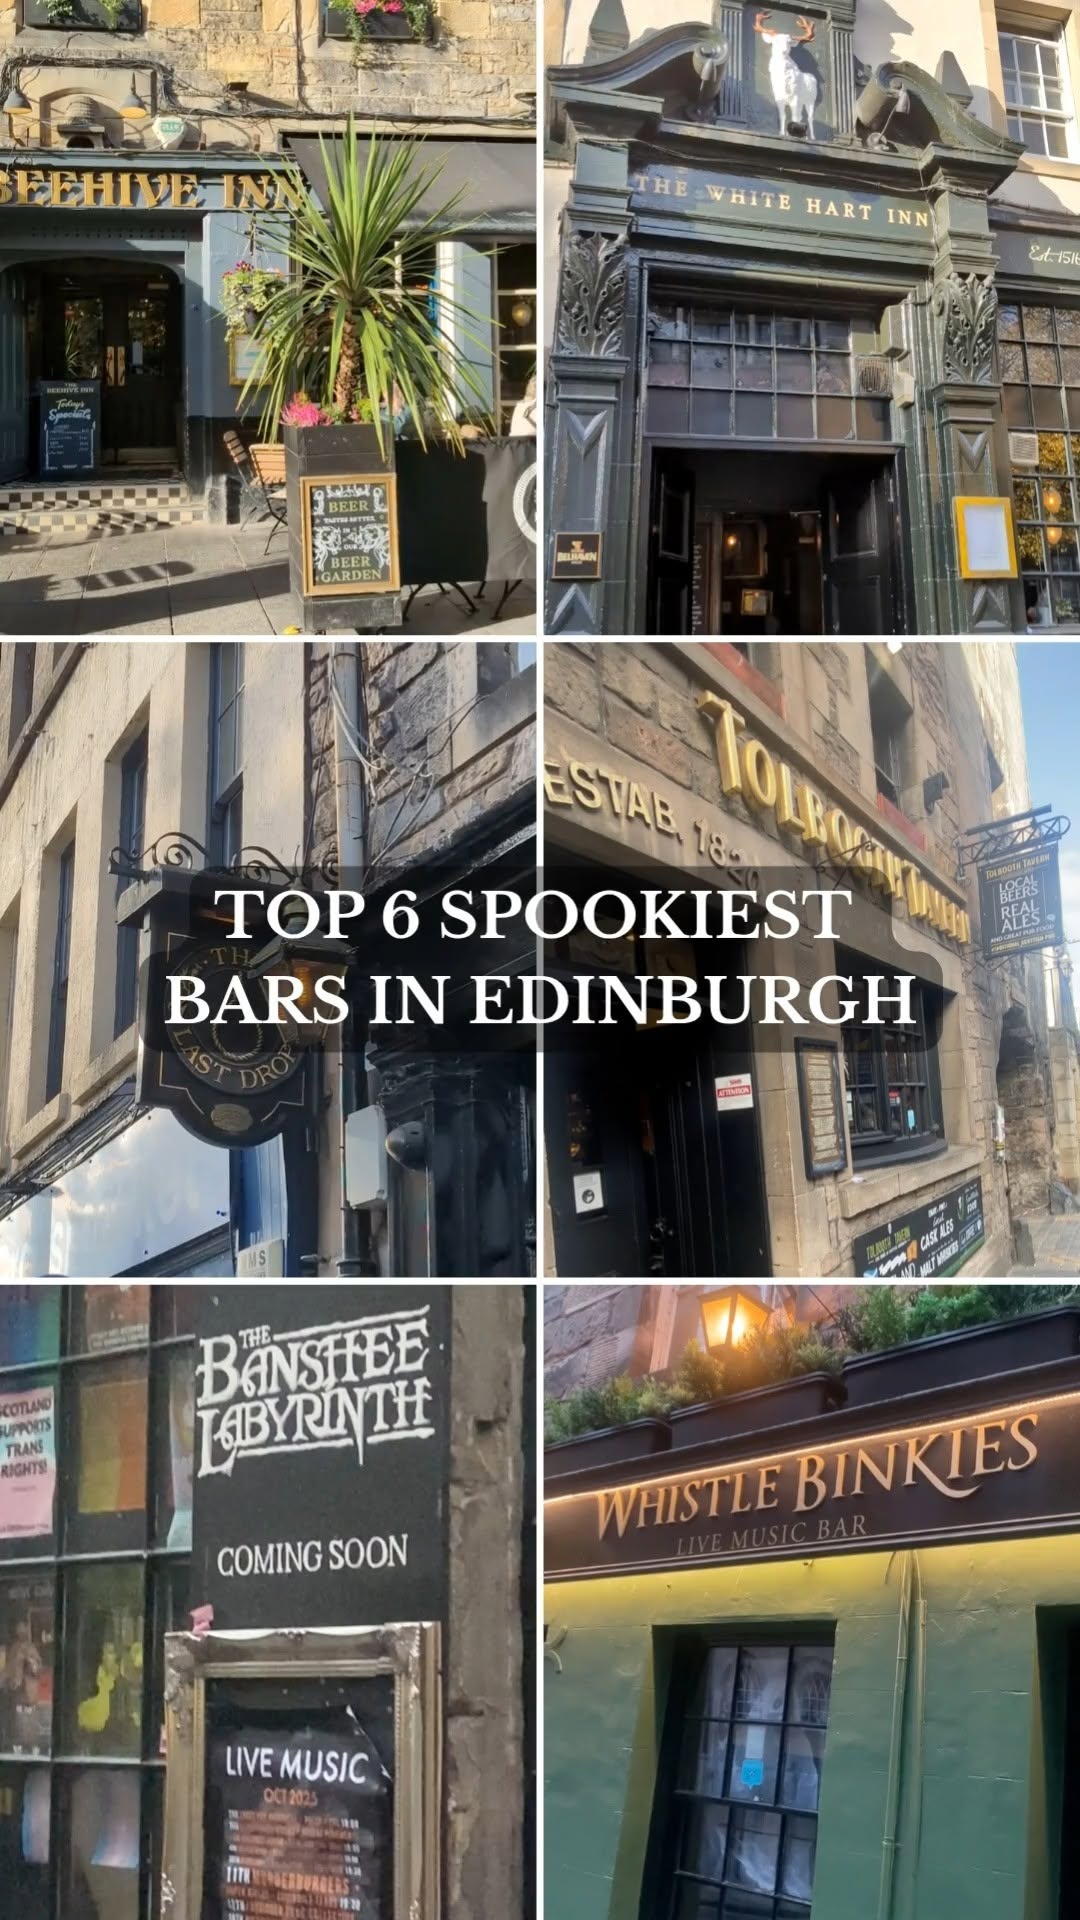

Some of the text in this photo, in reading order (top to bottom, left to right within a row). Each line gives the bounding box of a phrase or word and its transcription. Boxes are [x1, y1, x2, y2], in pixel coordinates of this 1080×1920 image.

[635, 175, 928, 227] THE WHITE HART INN
[1029, 245, 1053, 262] Est.
[328, 500, 369, 513] BEER
[331, 556, 371, 569] BEER
[321, 569, 382, 583] GARDEN
[986, 863, 1021, 880] TOLBOOTH
[1023, 853, 1050, 868] TAVERN
[1000, 873, 1035, 893] LOCAL
[1001, 881, 1039, 905] BEERS
[1001, 899, 1040, 919] REAL
[1002, 911, 1040, 933] ALES
[210, 946, 252, 967] TH
[173, 1028, 298, 1089] LAST DROP
[920, 1231, 938, 1252] CASK
[939, 1218, 954, 1237] ALES
[920, 1257, 935, 1277] MALT
[239, 1324, 271, 1348] THE
[196, 1318, 429, 1408] BANSHEE
[197, 1377, 433, 1478] LABYRINTH
[6, 1440, 43, 1457] TRANS
[1, 1459, 47, 1478] RIGHTS!
[599, 1413, 1039, 1541] WHISTLE BINKIES
[676, 1514, 867, 1557] LIVE MUSIC BAR
[217, 1533, 408, 1577] COMING SOON
[226, 1746, 369, 1784] LIVE MUSIC
[264, 1787, 287, 1804] OCT
[227, 1866, 250, 1884] 11TH
